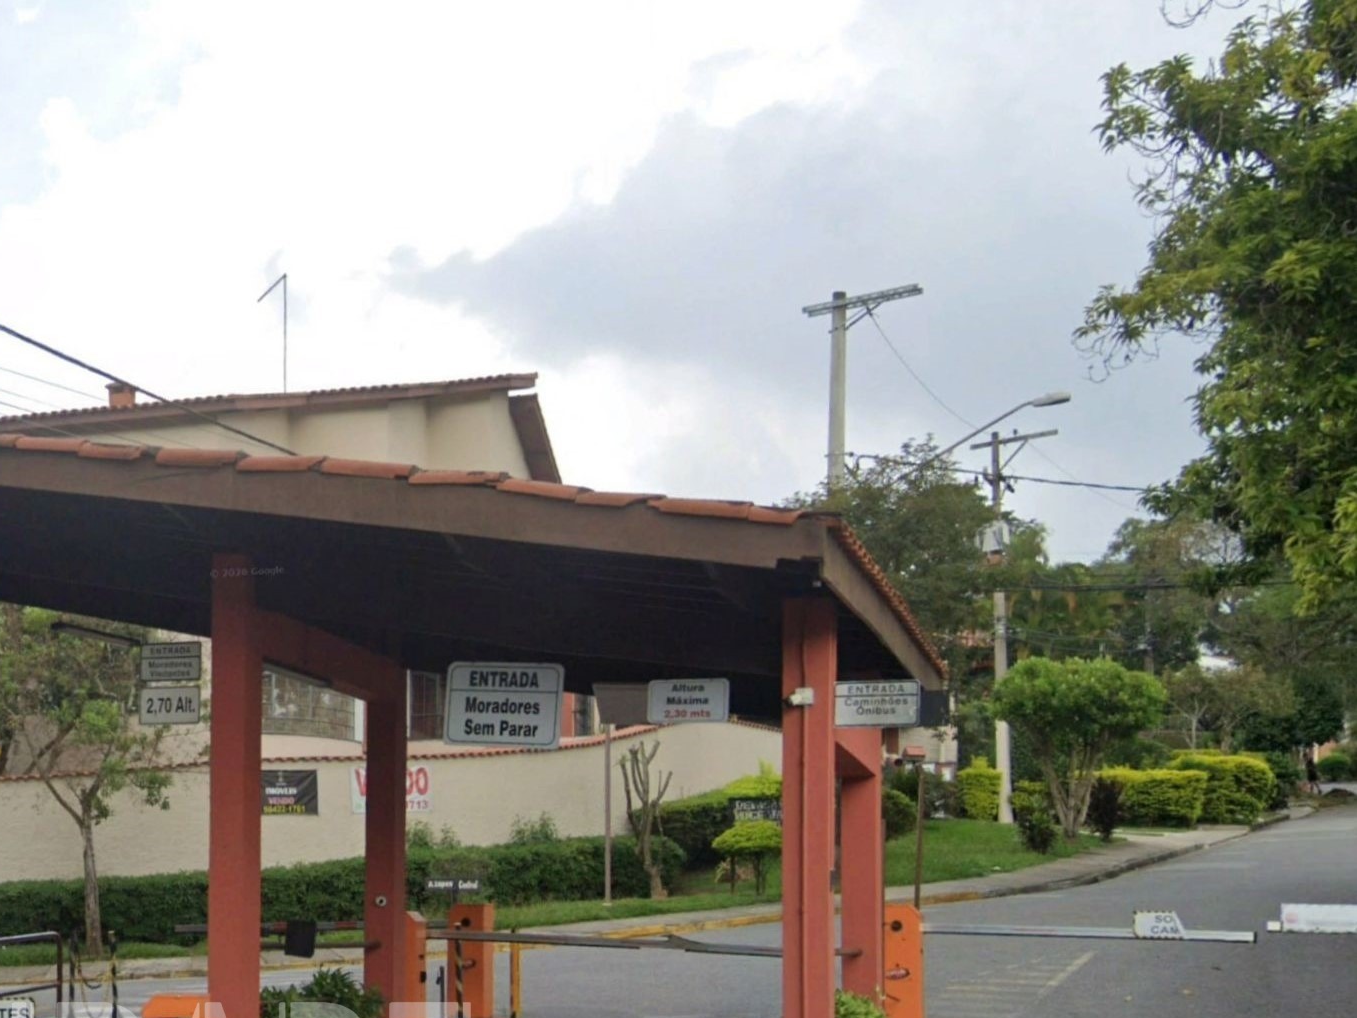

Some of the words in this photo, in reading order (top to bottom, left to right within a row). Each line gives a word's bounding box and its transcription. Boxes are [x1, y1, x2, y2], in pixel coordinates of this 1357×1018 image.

[149, 646, 191, 655] ENTRADA
[469, 670, 539, 688] ENTRADA
[671, 684, 705, 692] Altura
[847, 684, 906, 694] ENTRADA
[146, 697, 172, 717] 2,70
[175, 696, 196, 713] Alt.
[465, 696, 540, 714] Moradores
[844, 697, 908, 706] Caminhões
[690, 709, 711, 718] mts
[464, 719, 495, 735] Sem
[499, 720, 538, 738] Parar
